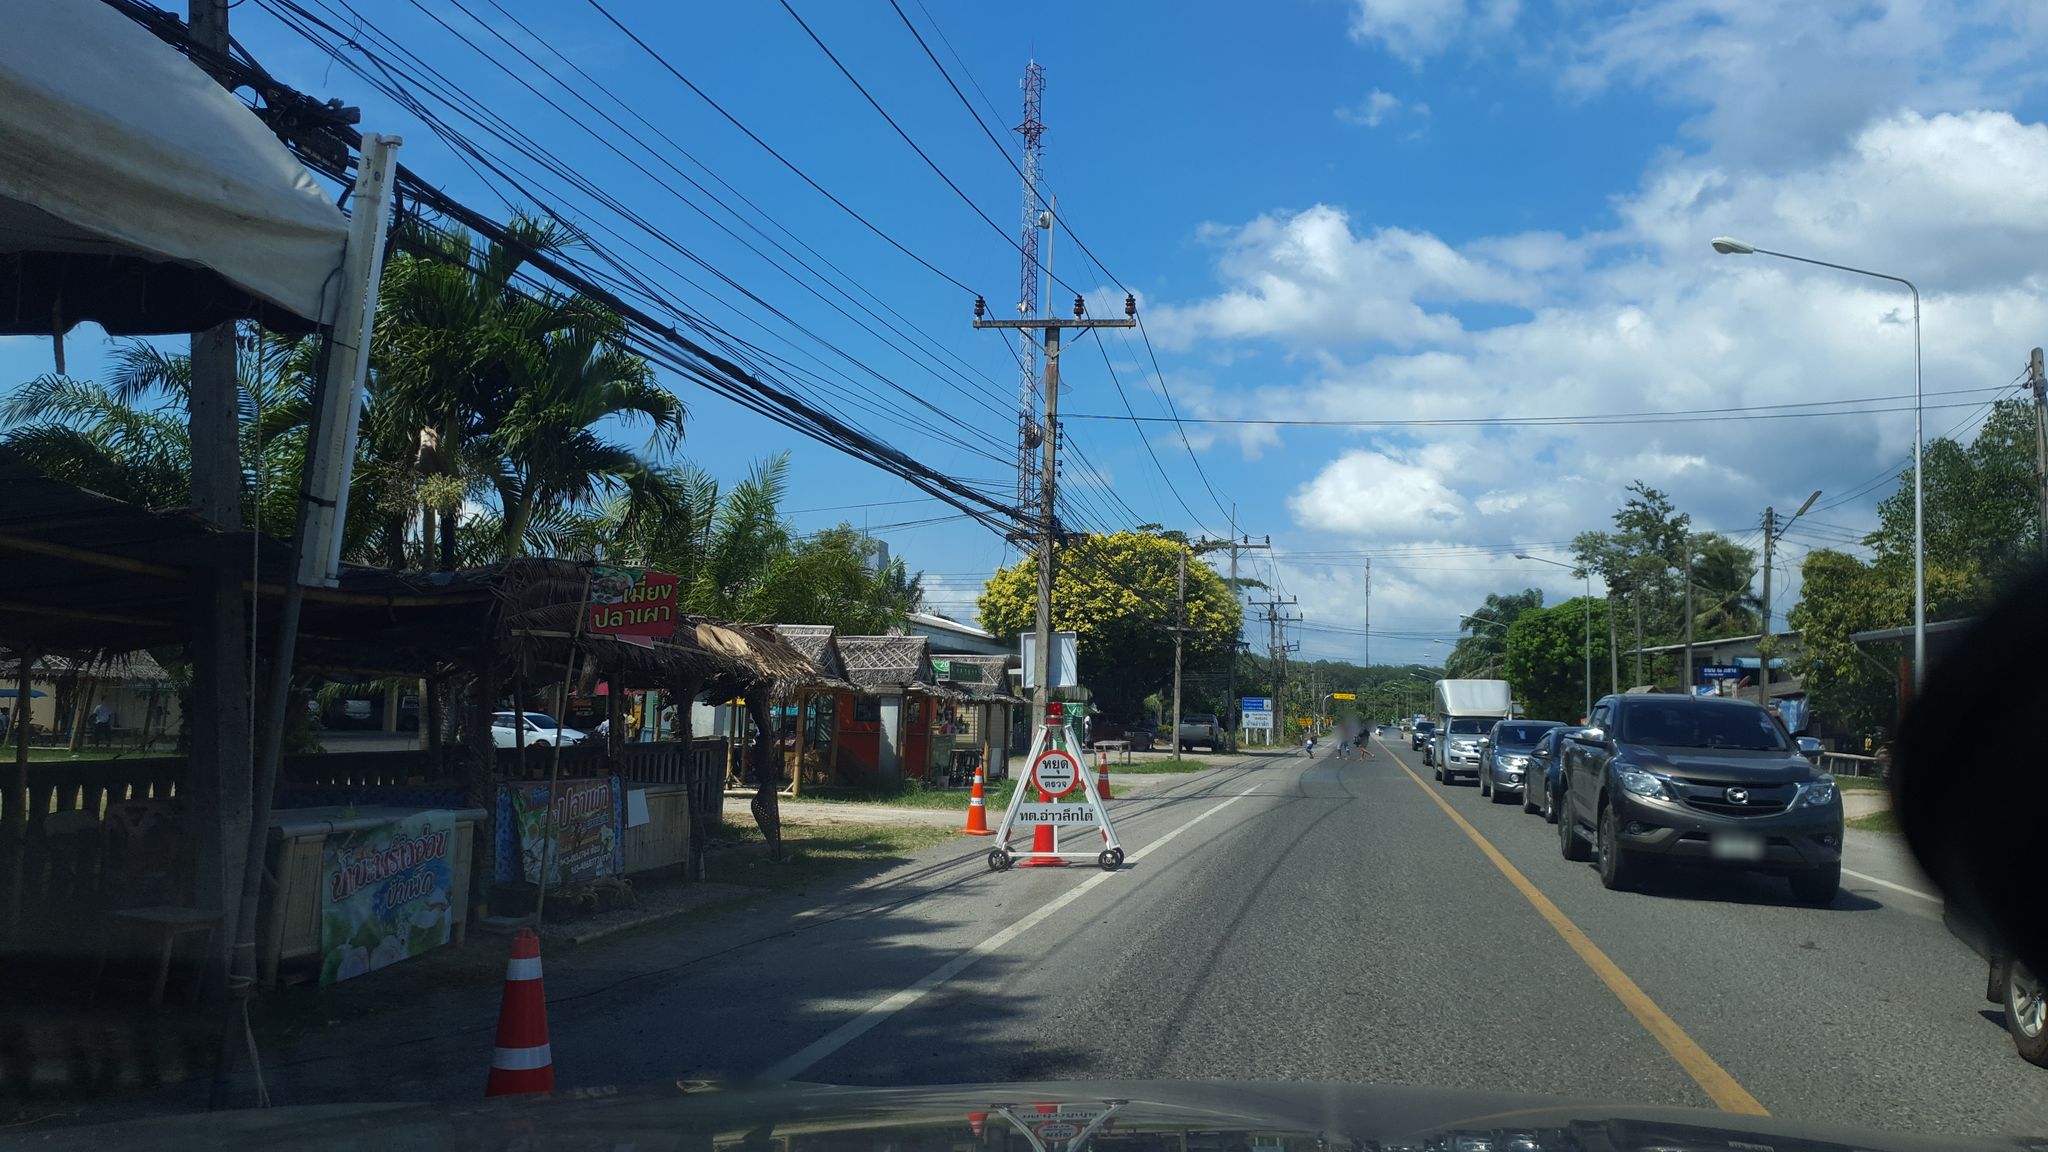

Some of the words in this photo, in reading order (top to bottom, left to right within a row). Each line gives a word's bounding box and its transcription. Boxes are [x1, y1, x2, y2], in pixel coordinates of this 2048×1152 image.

[623, 575, 673, 604] เมี่ยง
[594, 606, 671, 629] ปลาเผา
[1042, 759, 1069, 775] หยุด
[1044, 780, 1068, 788] ตรวจ
[1019, 807, 1094, 822] ทต.อ่าวลึกใต้
[331, 823, 450, 902] น้ำมะพร้าวอ่อน
